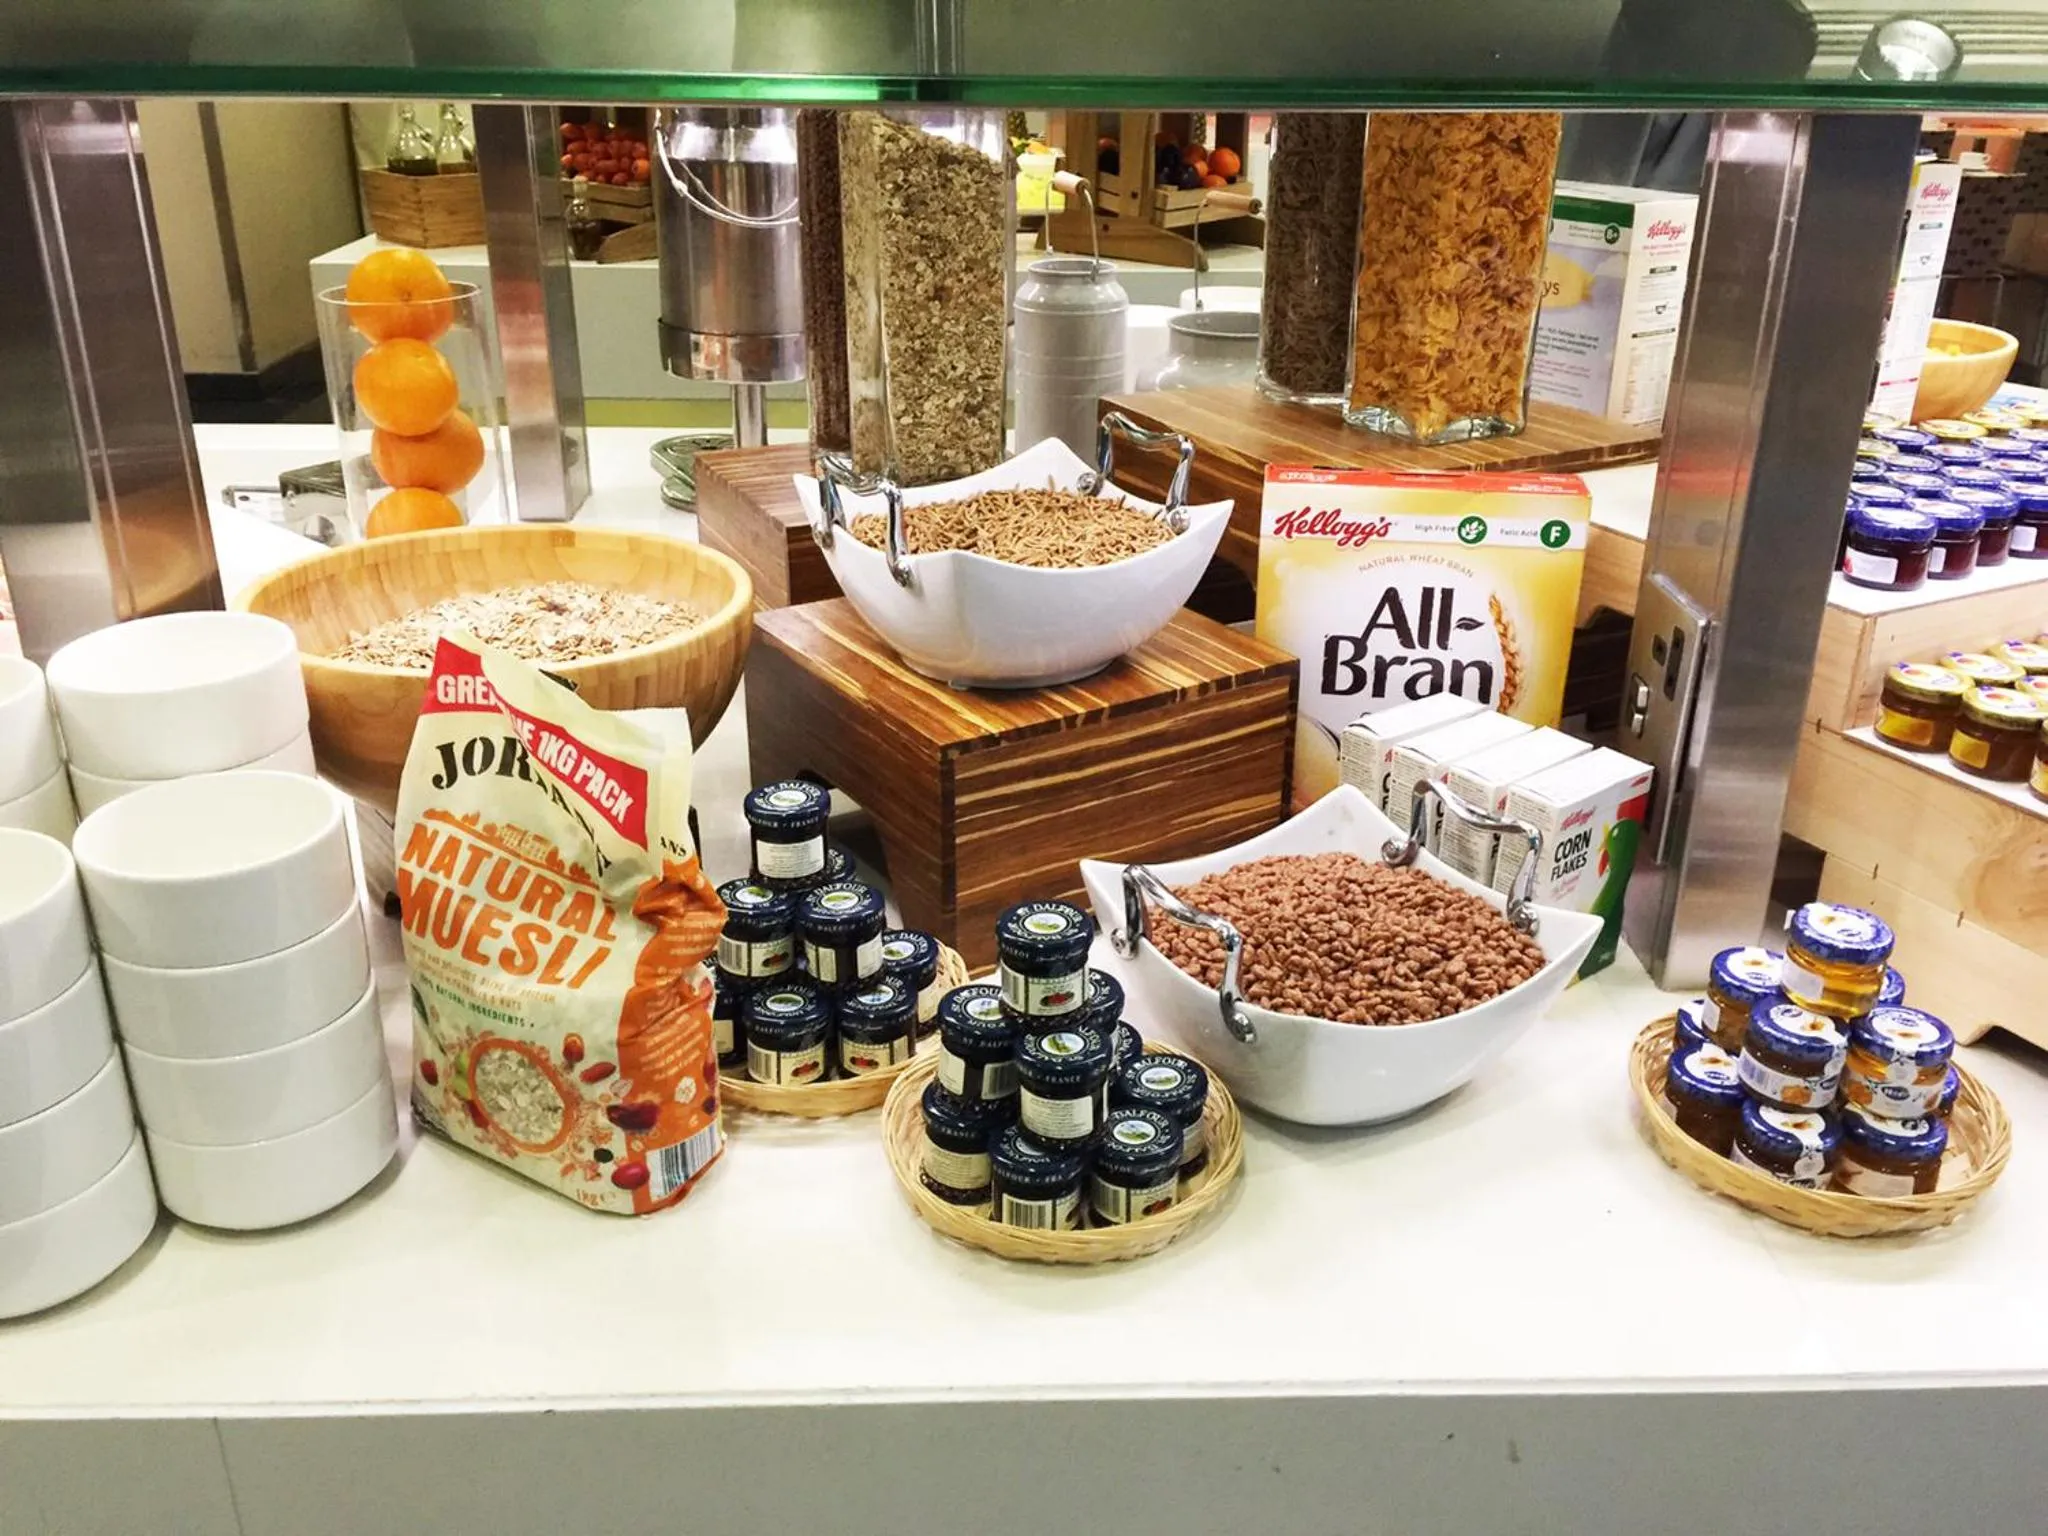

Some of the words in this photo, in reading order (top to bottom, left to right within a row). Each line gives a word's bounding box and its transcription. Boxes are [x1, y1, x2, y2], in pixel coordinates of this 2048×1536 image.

[1647, 220, 1687, 240] Kellogg's
[1273, 505, 1392, 548] Kellogg's
[1358, 553, 1405, 573] NATURAL
[1409, 554, 1445, 565] WHEAT
[1446, 559, 1474, 578] BRAN
[1320, 634, 1494, 705] Bran
[536, 730, 579, 776] 1KG
[573, 756, 634, 824] PACK
[1554, 827, 1593, 863] CORN
[1551, 851, 1588, 882] FLAKES
[400, 822, 618, 943] NATURAL
[812, 881, 869, 900] DALFOUR
[1032, 902, 1084, 923] DALFOUR
[398, 867, 612, 989] MUESLI
[952, 986, 1002, 1004] DALFOU
[467, 999, 526, 1028] INGREDIENTS
[1132, 1056, 1189, 1071] DALFOUR
[1110, 1109, 1170, 1129] DALFOUR
